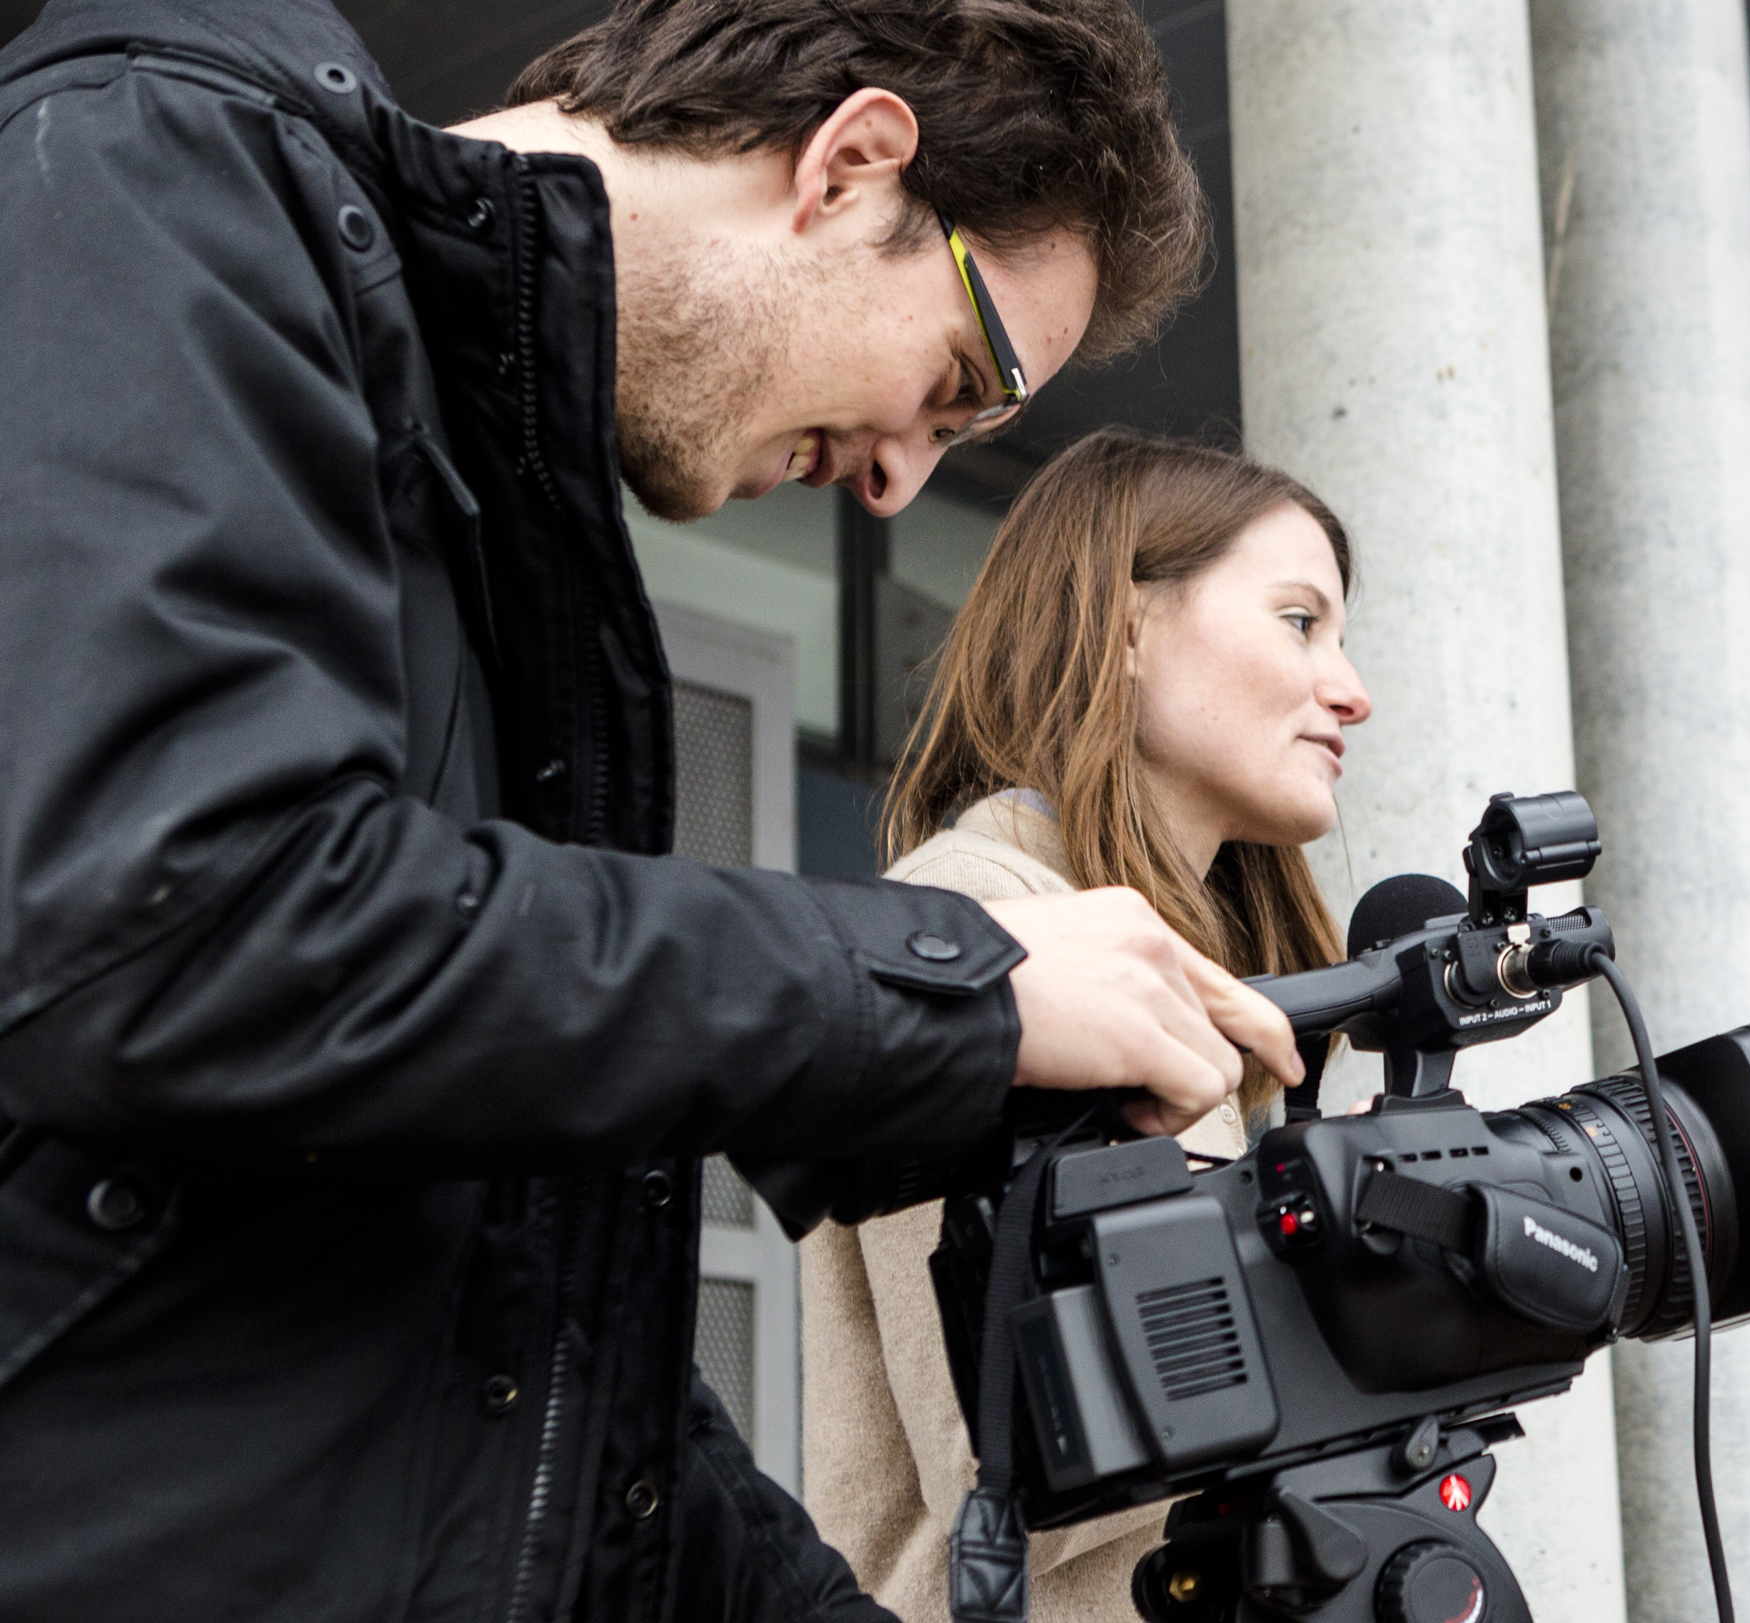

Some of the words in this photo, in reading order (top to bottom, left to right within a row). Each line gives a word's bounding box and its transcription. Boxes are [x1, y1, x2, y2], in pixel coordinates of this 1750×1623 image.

[1459, 1014, 1481, 1026] INPUT
[1482, 1013, 1487, 1022] 2
[1494, 1007, 1518, 1019] AUDIO
[1525, 1001, 1546, 1013] INPUT
[1547, 1000, 1552, 1009] 1
[1523, 1215, 1598, 1273] Panasonic
